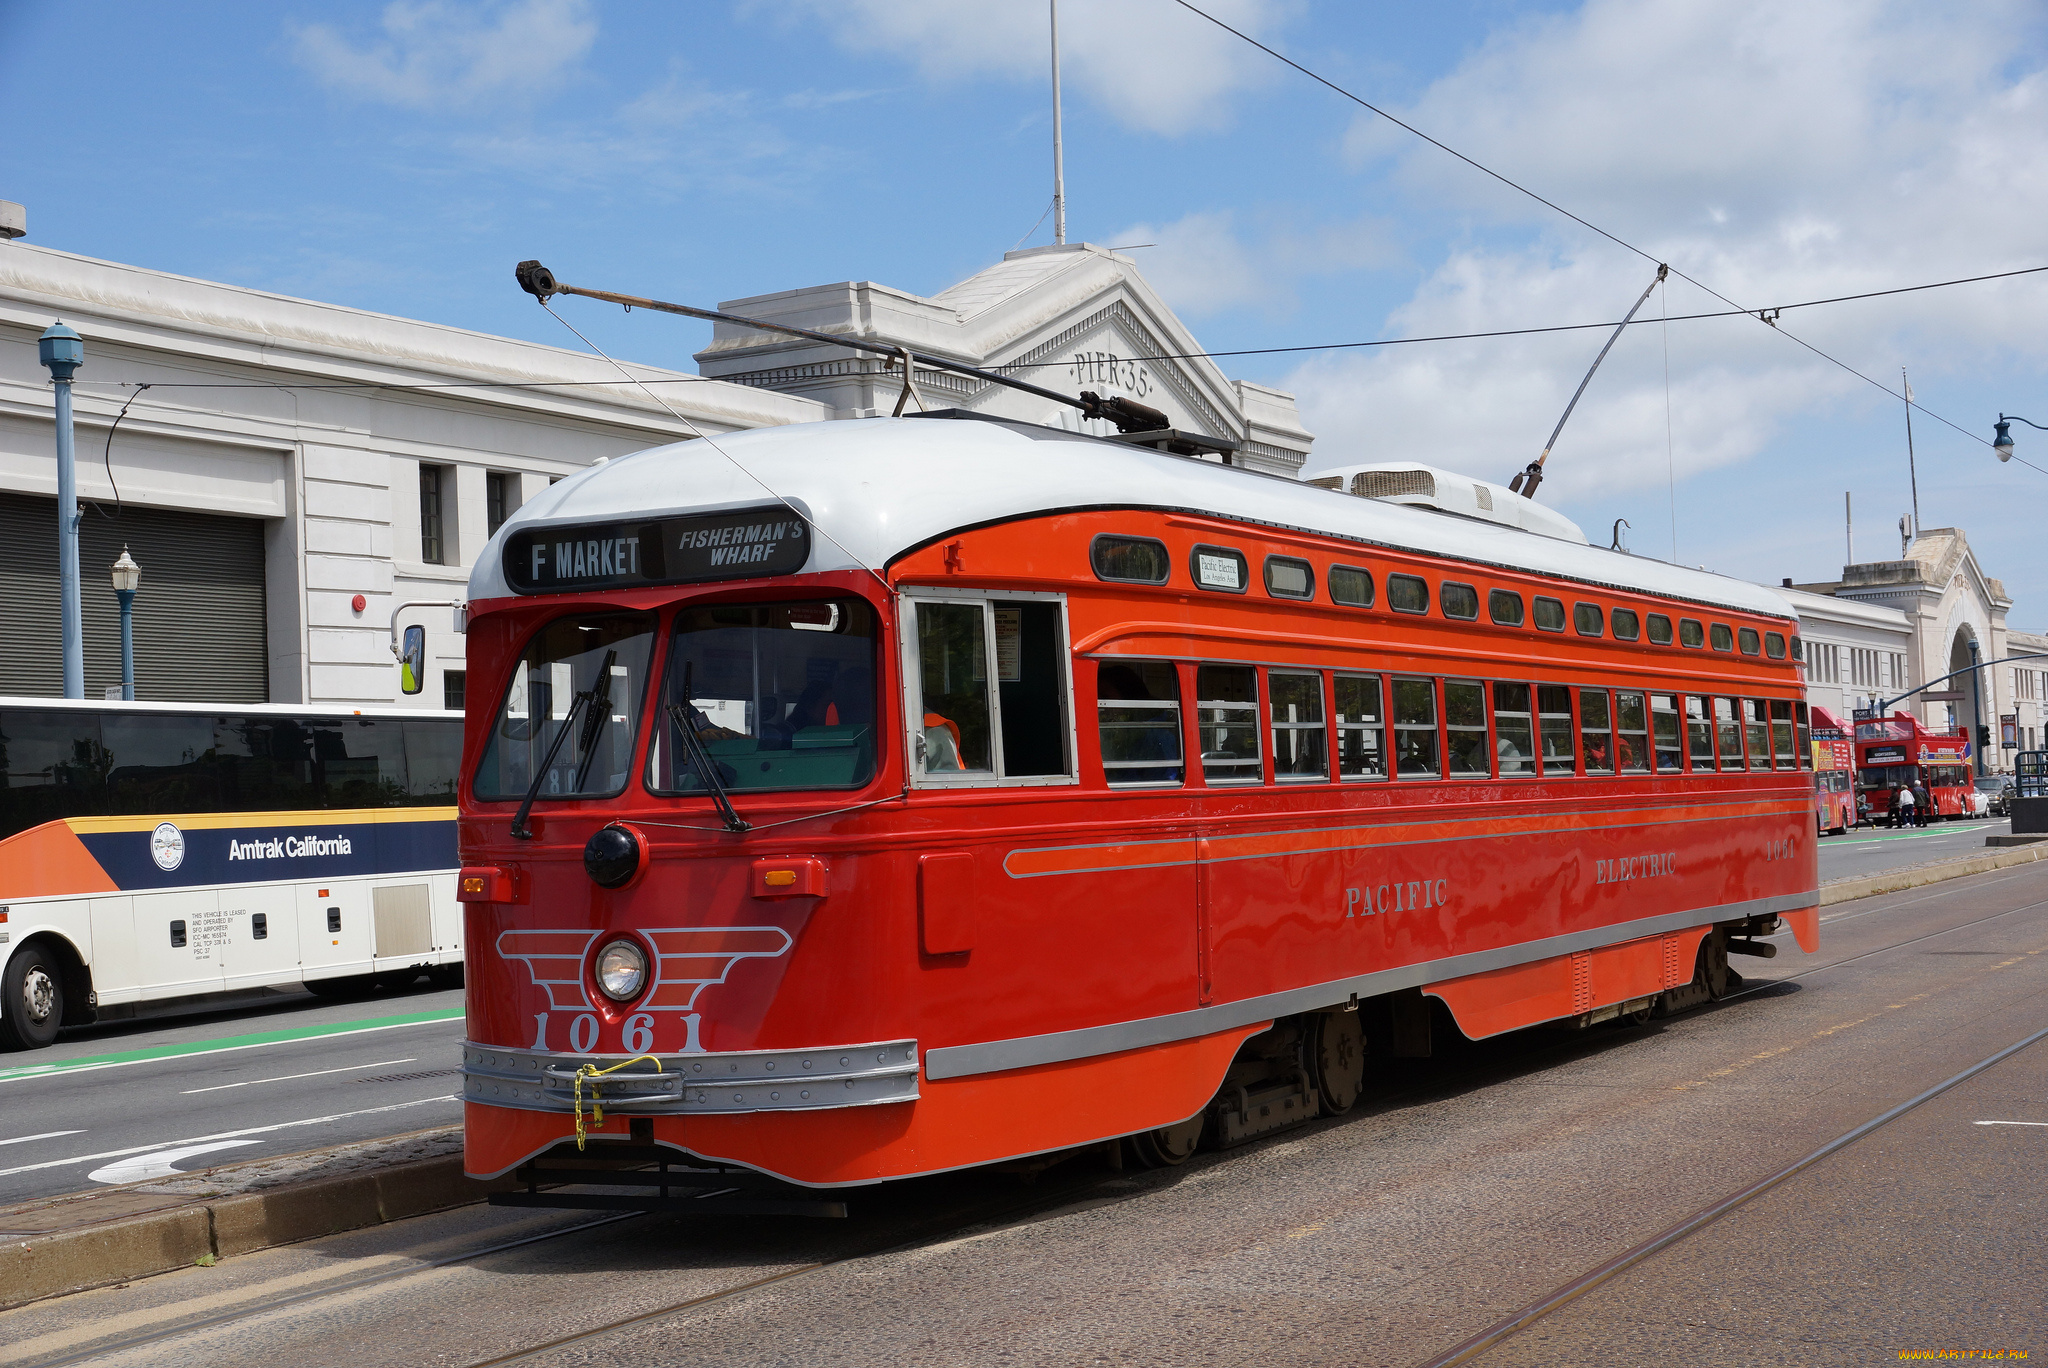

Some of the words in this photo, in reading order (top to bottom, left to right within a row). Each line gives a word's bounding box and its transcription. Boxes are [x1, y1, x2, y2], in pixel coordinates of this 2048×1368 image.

[1074, 351, 1120, 387] PIER
[1125, 360, 1148, 397] 35
[679, 520, 804, 550] FISHERMAN'S
[532, 544, 546, 580] F
[556, 537, 639, 579] MARKET
[710, 543, 777, 566] WHARF
[1201, 557, 1217, 571] Pacific
[1218, 559, 1237, 574] Electric
[1212, 573, 1226, 582] Angeles
[229, 837, 285, 861] Amtrak
[285, 834, 352, 858] California
[1767, 838, 1795, 861] 1061
[1345, 878, 1447, 918] PACIFIC
[1596, 852, 1676, 884] ELECTRIC
[203, 918, 226, 926] OPERATED
[203, 924, 229, 932] AIRPORTER
[530, 1012, 706, 1054] 1061
